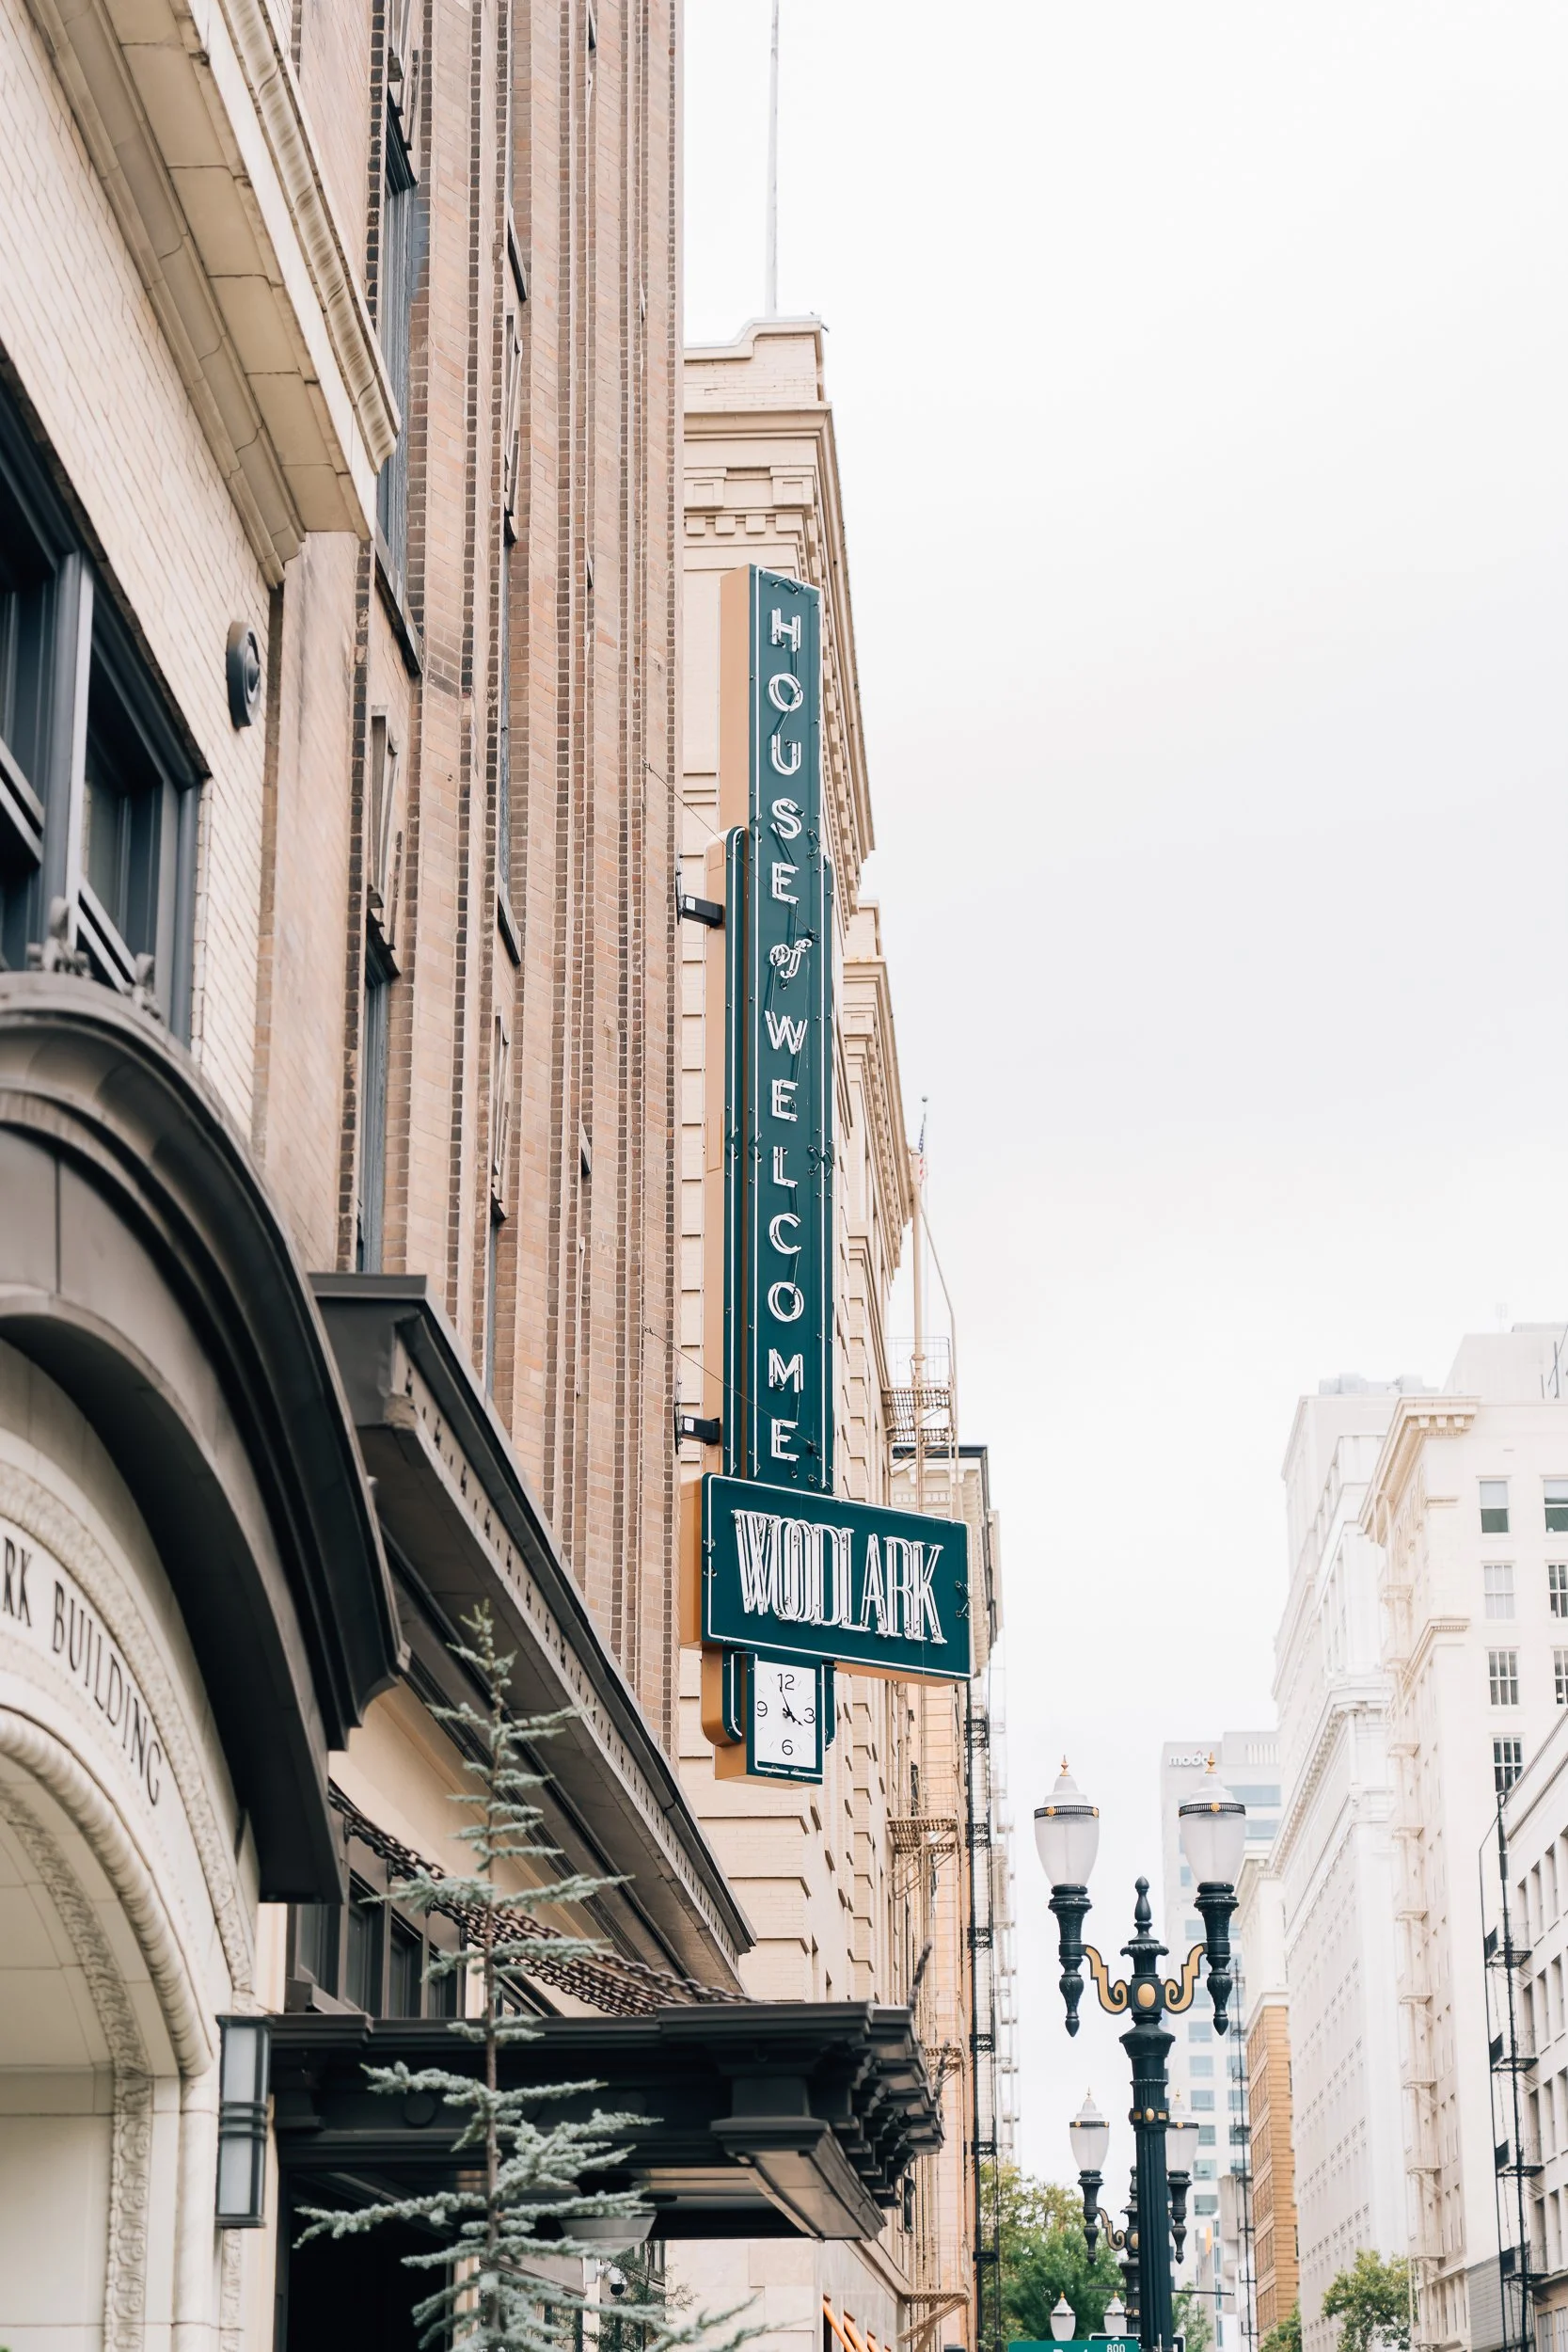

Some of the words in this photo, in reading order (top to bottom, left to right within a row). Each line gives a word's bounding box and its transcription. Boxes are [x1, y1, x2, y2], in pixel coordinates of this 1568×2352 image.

[768, 607, 804, 905] HOUSE
[769, 938, 813, 979] of
[764, 1009, 808, 1463] WELCOME
[730, 1508, 948, 1645] WOODLARK
[52, 1580, 163, 1806] BUILDING
[777, 1673, 795, 1691] 12
[756, 1700, 768, 1718] 9
[803, 1707, 816, 1724] 3
[781, 1739, 794, 1756] 6
